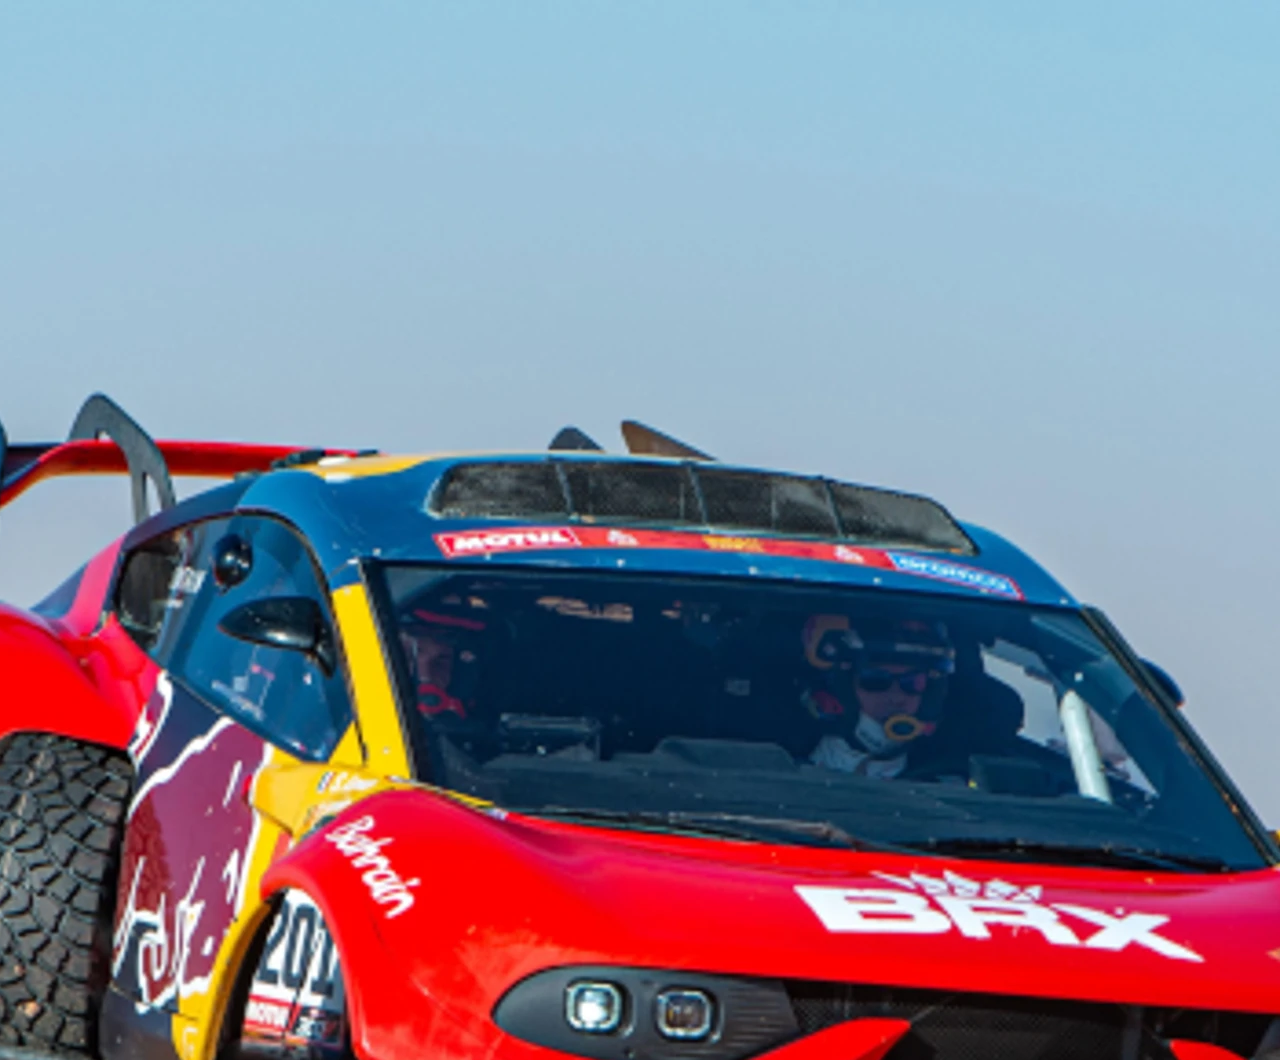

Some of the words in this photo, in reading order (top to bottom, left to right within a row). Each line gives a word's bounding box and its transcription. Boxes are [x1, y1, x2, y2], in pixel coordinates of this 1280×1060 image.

[454, 528, 575, 551] MOTUL
[324, 815, 422, 919] Bahrain
[793, 885, 1206, 963] BRX
